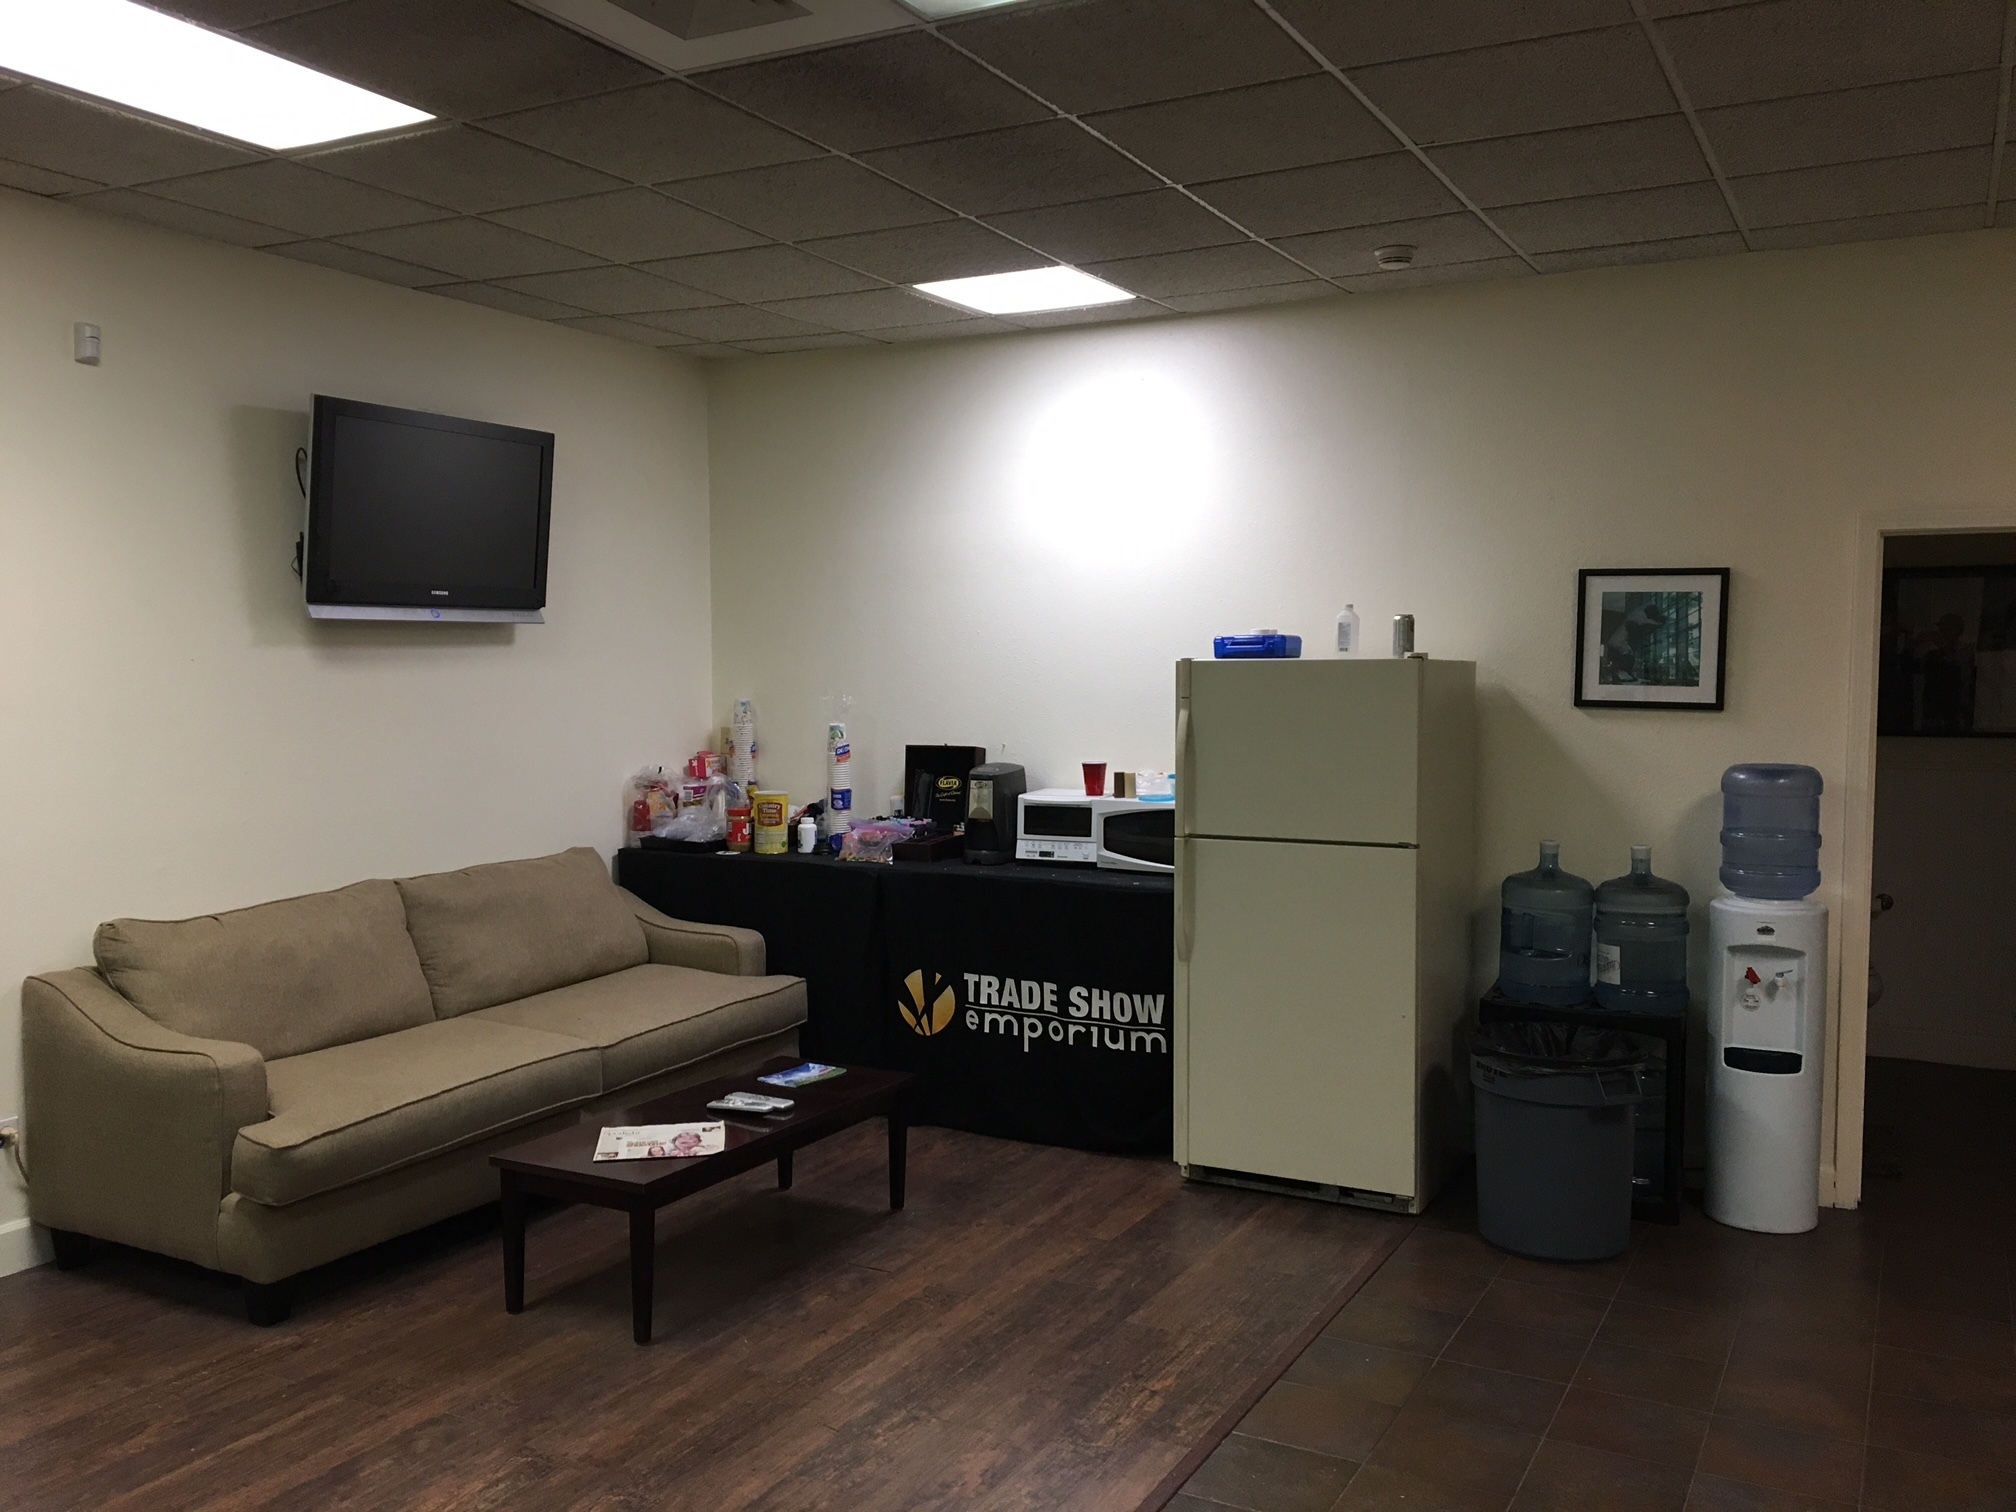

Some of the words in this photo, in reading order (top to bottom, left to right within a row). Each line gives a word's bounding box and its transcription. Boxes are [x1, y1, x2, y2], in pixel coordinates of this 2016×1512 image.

[963, 972, 1059, 1014] TRADE
[1068, 985, 1165, 1025] SHOW
[965, 1009, 1167, 1053] emporium
